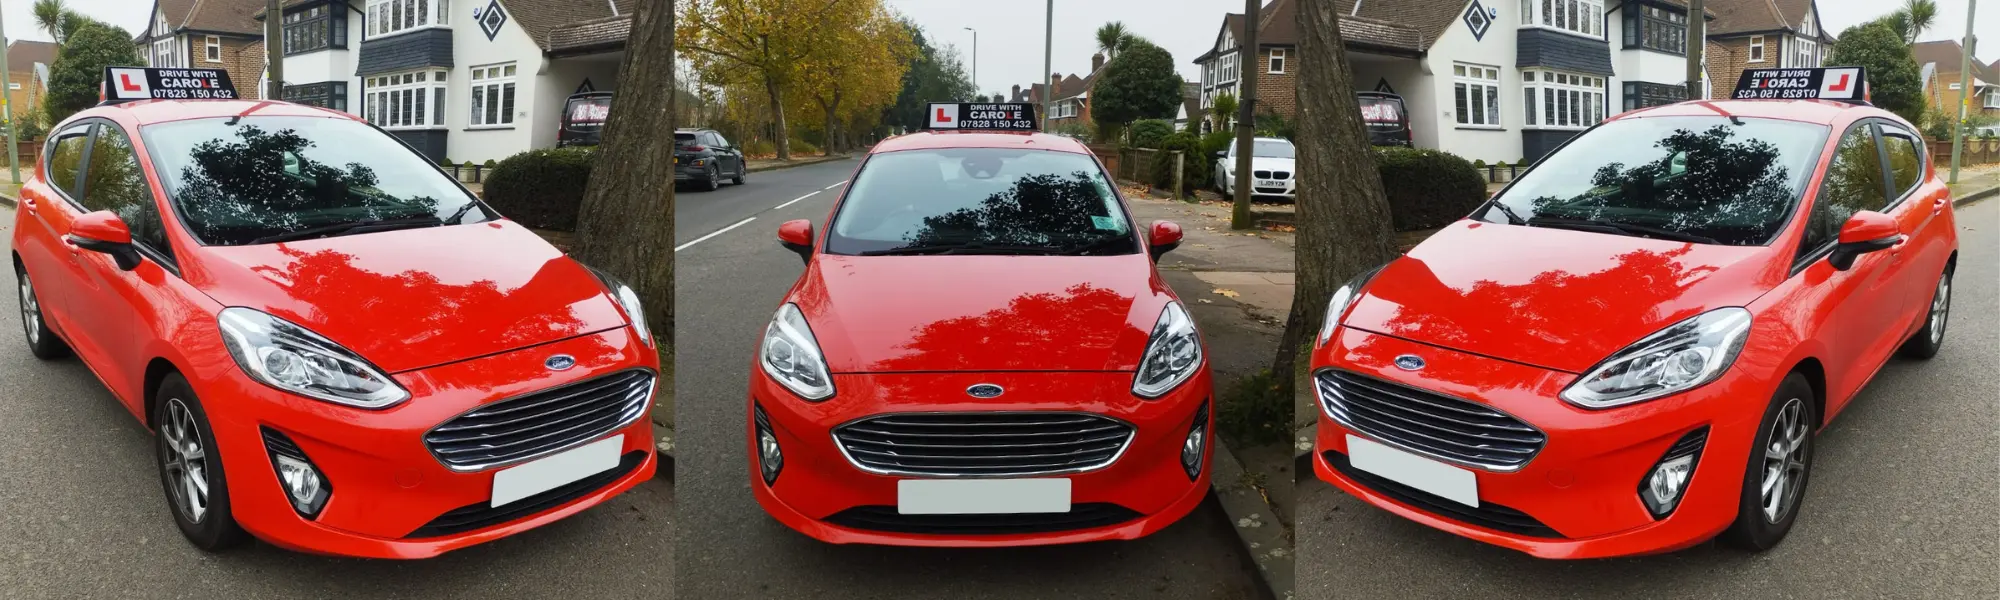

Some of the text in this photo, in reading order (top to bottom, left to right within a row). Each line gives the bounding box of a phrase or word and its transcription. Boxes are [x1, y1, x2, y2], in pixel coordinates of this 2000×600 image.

[120, 74, 141, 91] L
[161, 78, 220, 88] CAROLE
[153, 89, 233, 98] 07828 150 432
[936, 108, 952, 122] L
[970, 111, 1022, 119] CAROLE
[960, 120, 1031, 128] 07828 150 432
